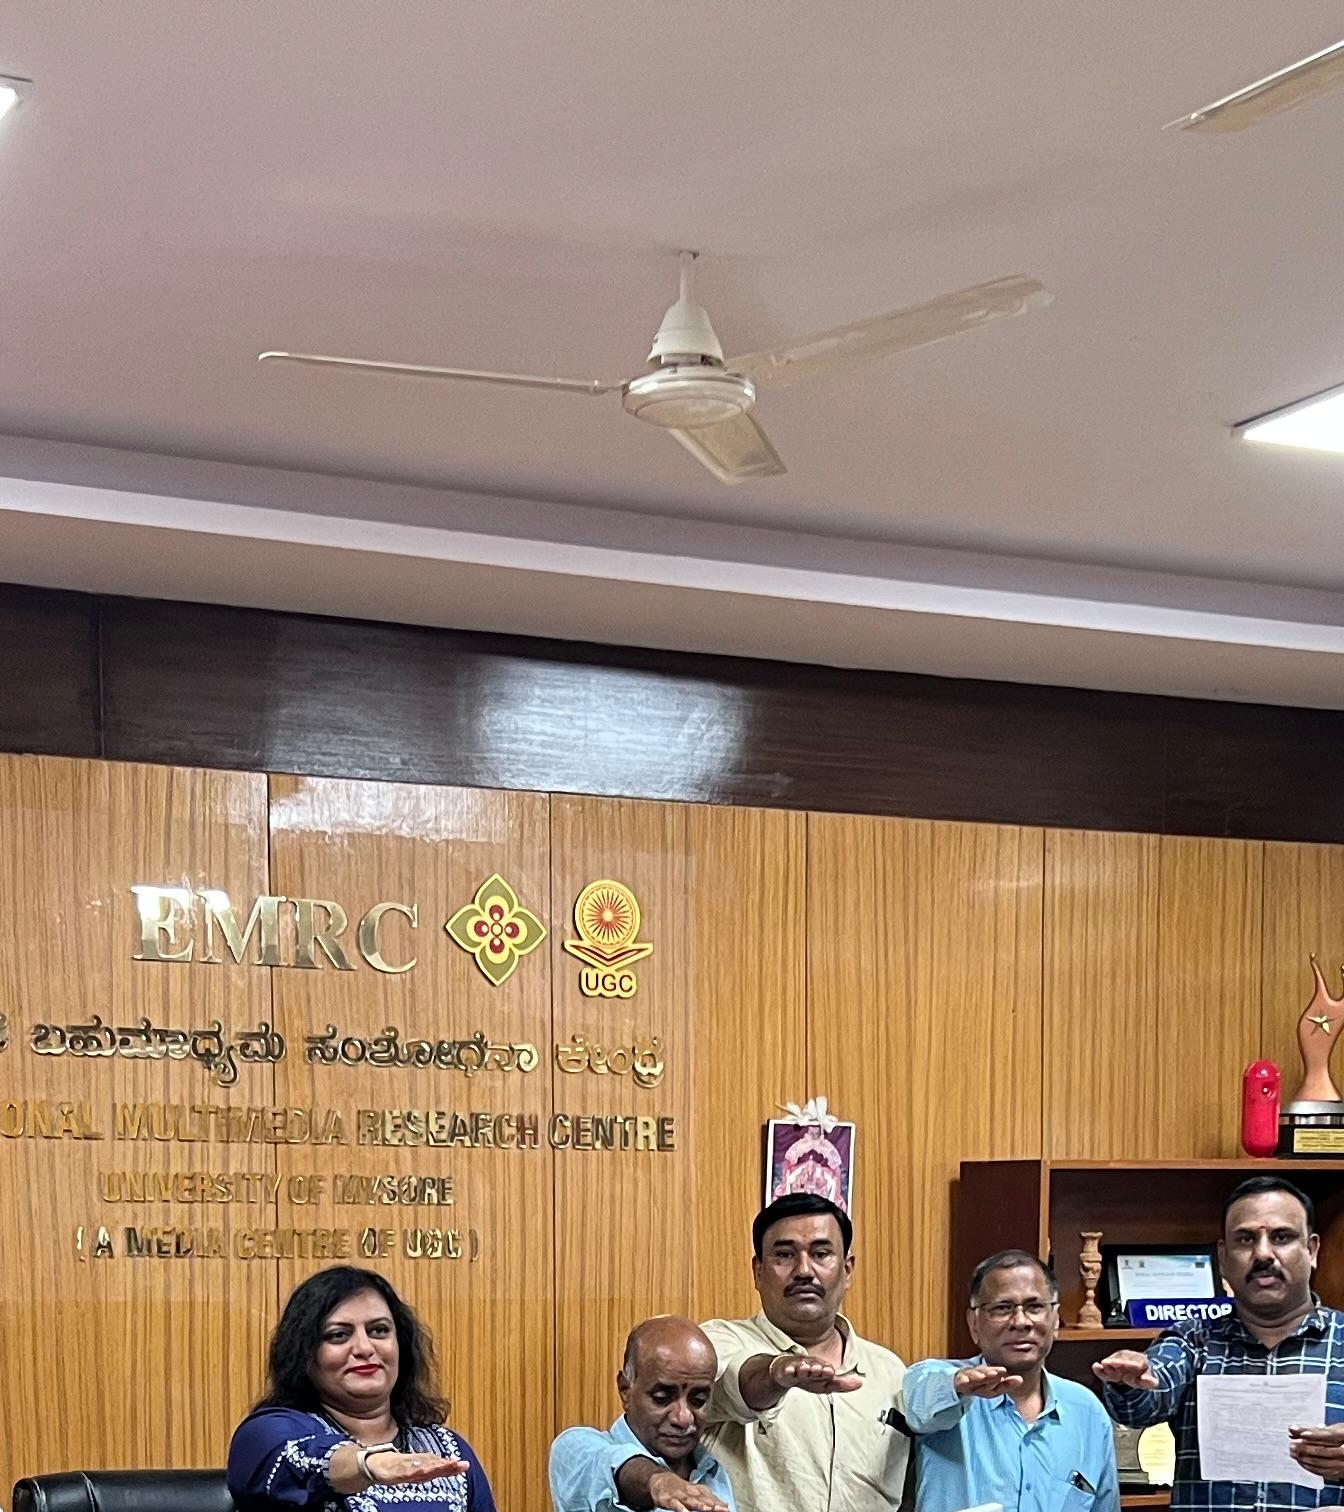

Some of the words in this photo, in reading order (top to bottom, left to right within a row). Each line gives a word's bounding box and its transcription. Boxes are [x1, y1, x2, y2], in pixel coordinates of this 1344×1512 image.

[130, 885, 419, 974] EMRC
[585, 972, 634, 993] UGC
[555, 1033, 665, 1088] ಕೇಂದ್ರ
[116, 1101, 347, 1145] MULTIMEDIA
[358, 1109, 539, 1149] RESEARCH
[548, 1112, 675, 1152] CENTRE
[101, 1171, 281, 1205] UNIVERSITY
[288, 1174, 326, 1205] OF
[334, 1174, 454, 1206] MYSORE
[124, 1225, 226, 1259] MEDIA
[234, 1227, 352, 1260] CENTRE
[362, 1227, 395, 1259] OF
